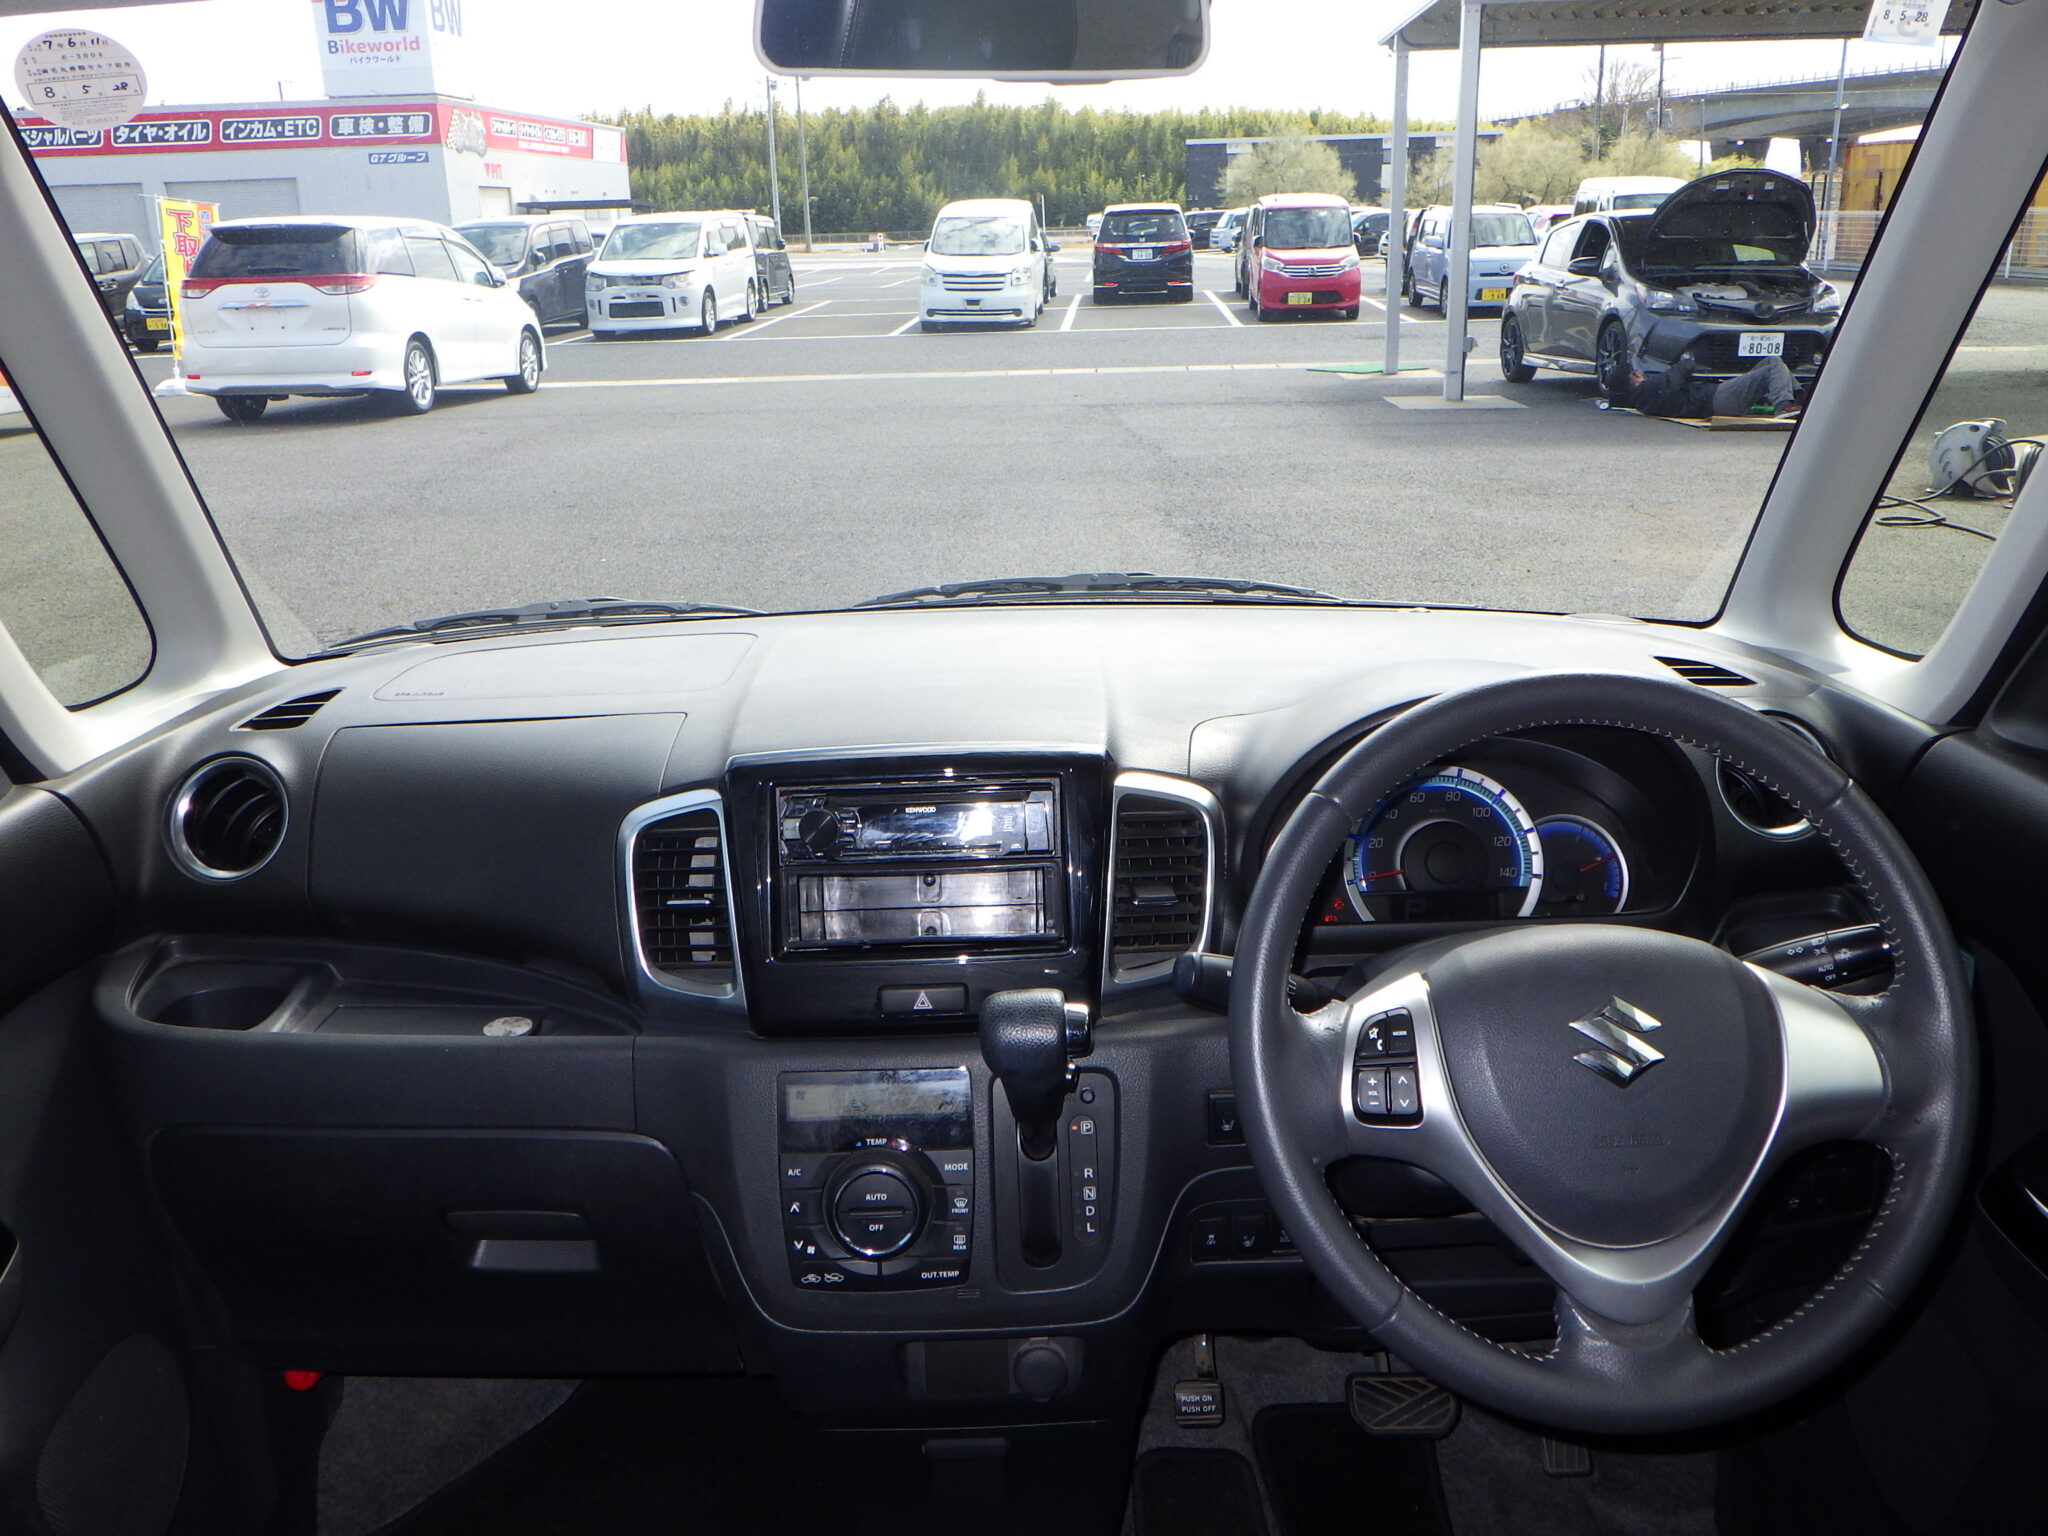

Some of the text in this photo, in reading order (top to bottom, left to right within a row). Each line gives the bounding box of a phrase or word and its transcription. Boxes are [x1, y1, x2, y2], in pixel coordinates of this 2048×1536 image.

[324, 0, 408, 33] BW
[430, 0, 462, 37] BW
[1883, 9, 1929, 23] 8 5 28
[42, 40, 52, 49] 7
[67, 37, 76, 47] 6
[327, 36, 421, 54] Bikeworld
[44, 82, 129, 98] 8 5 28
[224, 119, 317, 138] インカム・ETC
[337, 115, 425, 135] 車検・整備
[115, 123, 208, 143] タイヤ・オイル
[1748, 343, 1781, 354] 80-08
[1410, 792, 1425, 803] 60
[1445, 791, 1461, 802] 80
[904, 806, 937, 814] KENWOOD
[1472, 807, 1491, 818] 100
[1368, 838, 1384, 849] 20
[1494, 836, 1512, 847] 120
[1500, 867, 1518, 878] 140
[1818, 964, 1834, 972] AUTO
[1082, 1122, 1092, 1133] P
[866, 1138, 888, 1146] TEMP
[788, 1169, 801, 1177] A/C
[944, 1163, 969, 1172] MODE
[1084, 1168, 1093, 1178] R
[865, 1193, 887, 1201] AUTO
[1085, 1188, 1095, 1199] N
[1086, 1206, 1095, 1216] D
[868, 1224, 884, 1232] OFF
[1087, 1222, 1095, 1232] L
[921, 1271, 959, 1279] OUT.TEMP
[1181, 1405, 1200, 1413] PUSH
